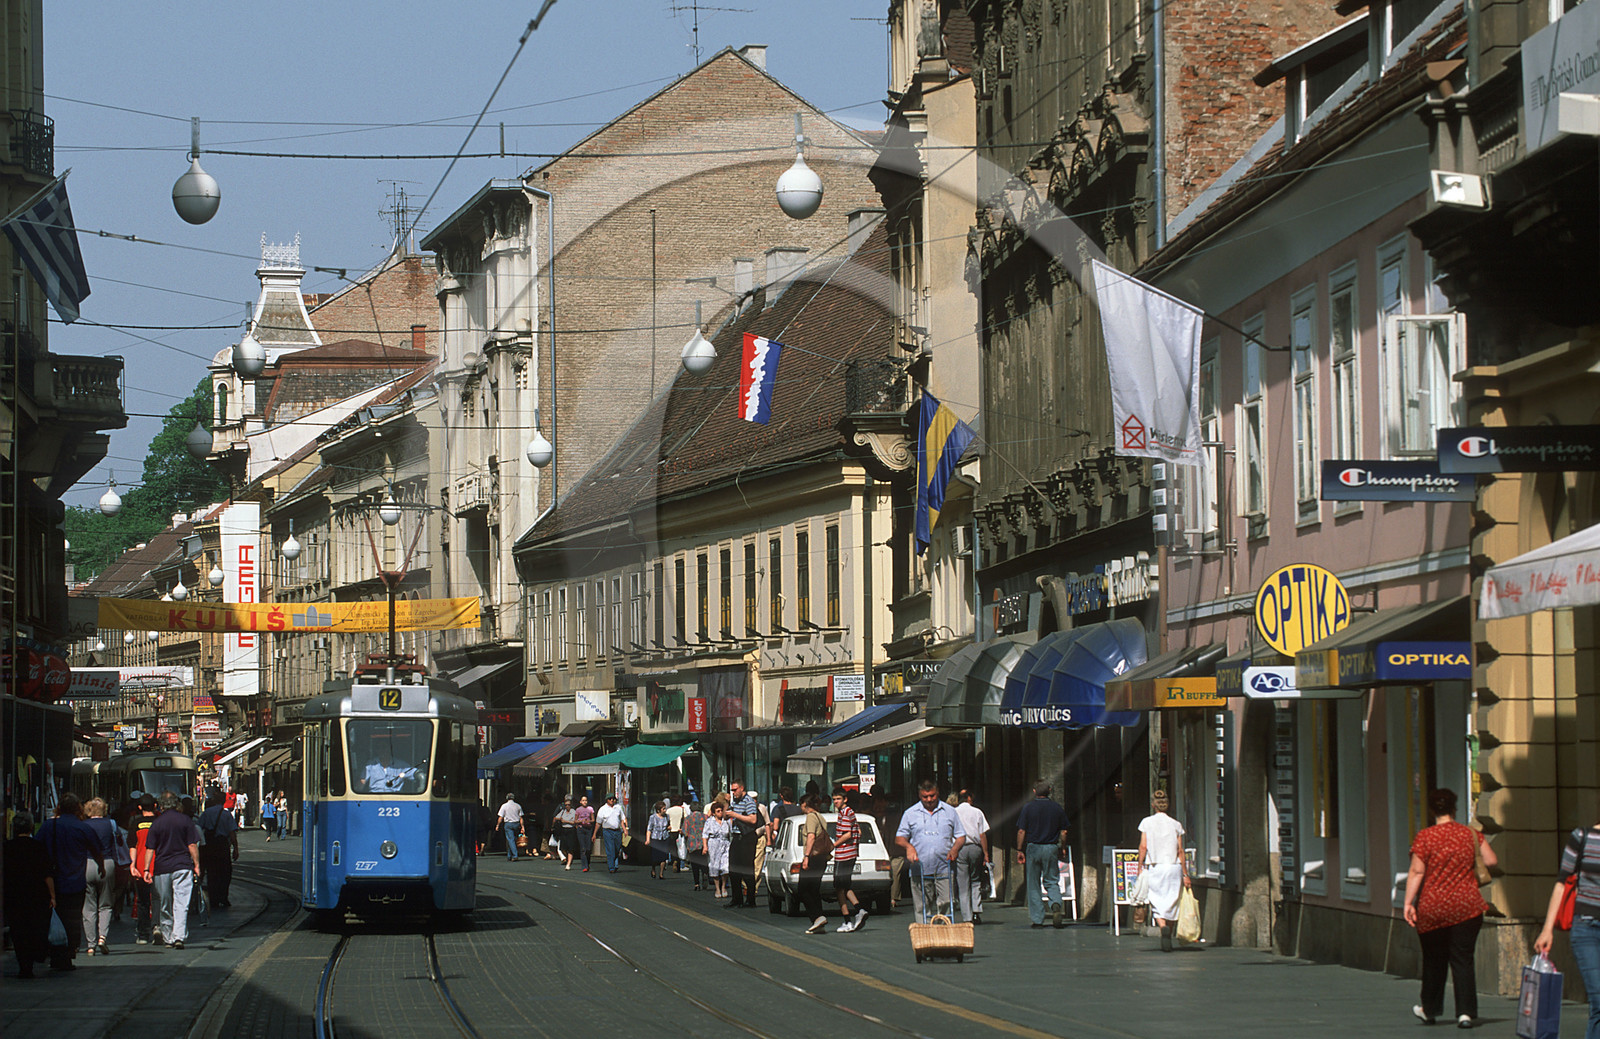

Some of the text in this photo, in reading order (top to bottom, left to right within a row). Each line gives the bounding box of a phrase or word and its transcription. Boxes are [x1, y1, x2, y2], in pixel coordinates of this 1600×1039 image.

[1550, 57, 1575, 99] British
[1457, 436, 1595, 462] Champion
[1338, 467, 1460, 493] Champion
[126, 605, 286, 631] VATROSLAV KULIŠ
[1259, 567, 1348, 649] OPTIKA
[1338, 652, 1377, 677] OPTIKA
[1388, 653, 1471, 666] OPTIKA
[381, 688, 399, 707] 12
[378, 807, 400, 817] 223
[356, 861, 378, 871] ZET
